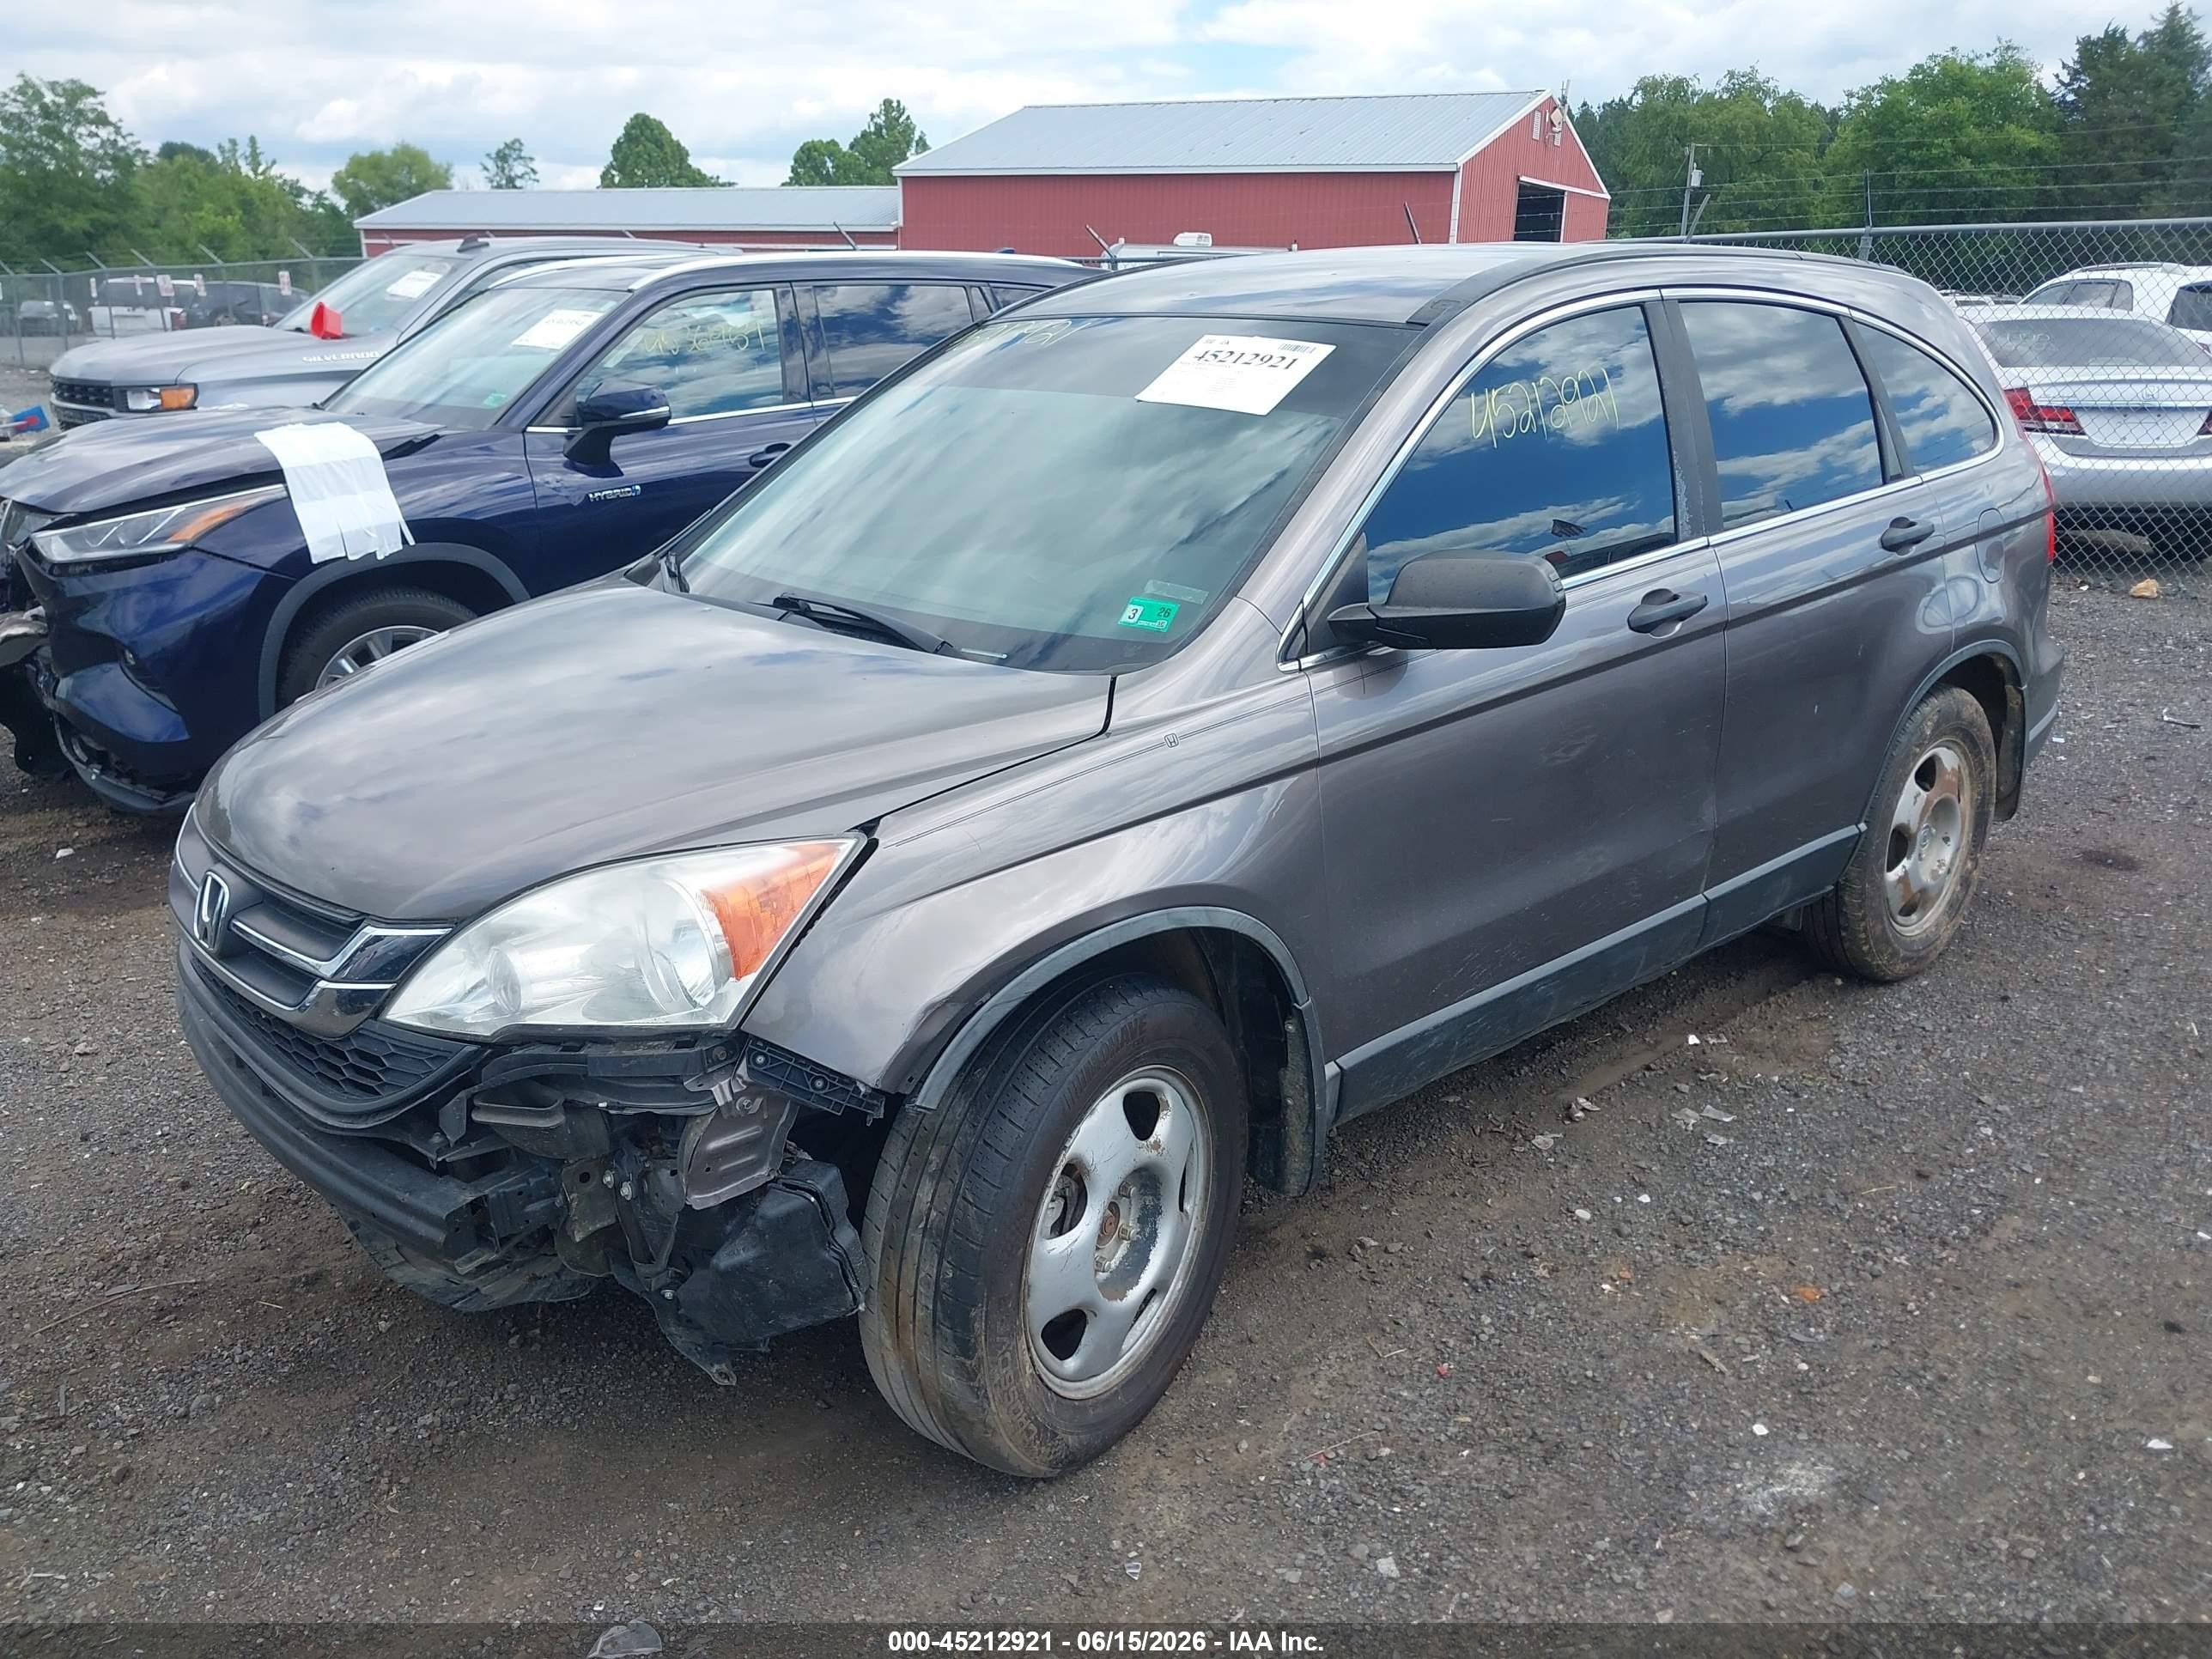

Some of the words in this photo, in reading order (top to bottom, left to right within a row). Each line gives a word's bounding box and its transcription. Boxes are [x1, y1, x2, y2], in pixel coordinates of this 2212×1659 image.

[302, 350, 380, 362] SILVERADO
[1194, 349, 1299, 370] 45212921
[1470, 367, 1620, 449] 45212921
[588, 487, 632, 502] HYBRID
[1127, 608, 1139, 620] 3
[1157, 606, 1171, 618] 26
